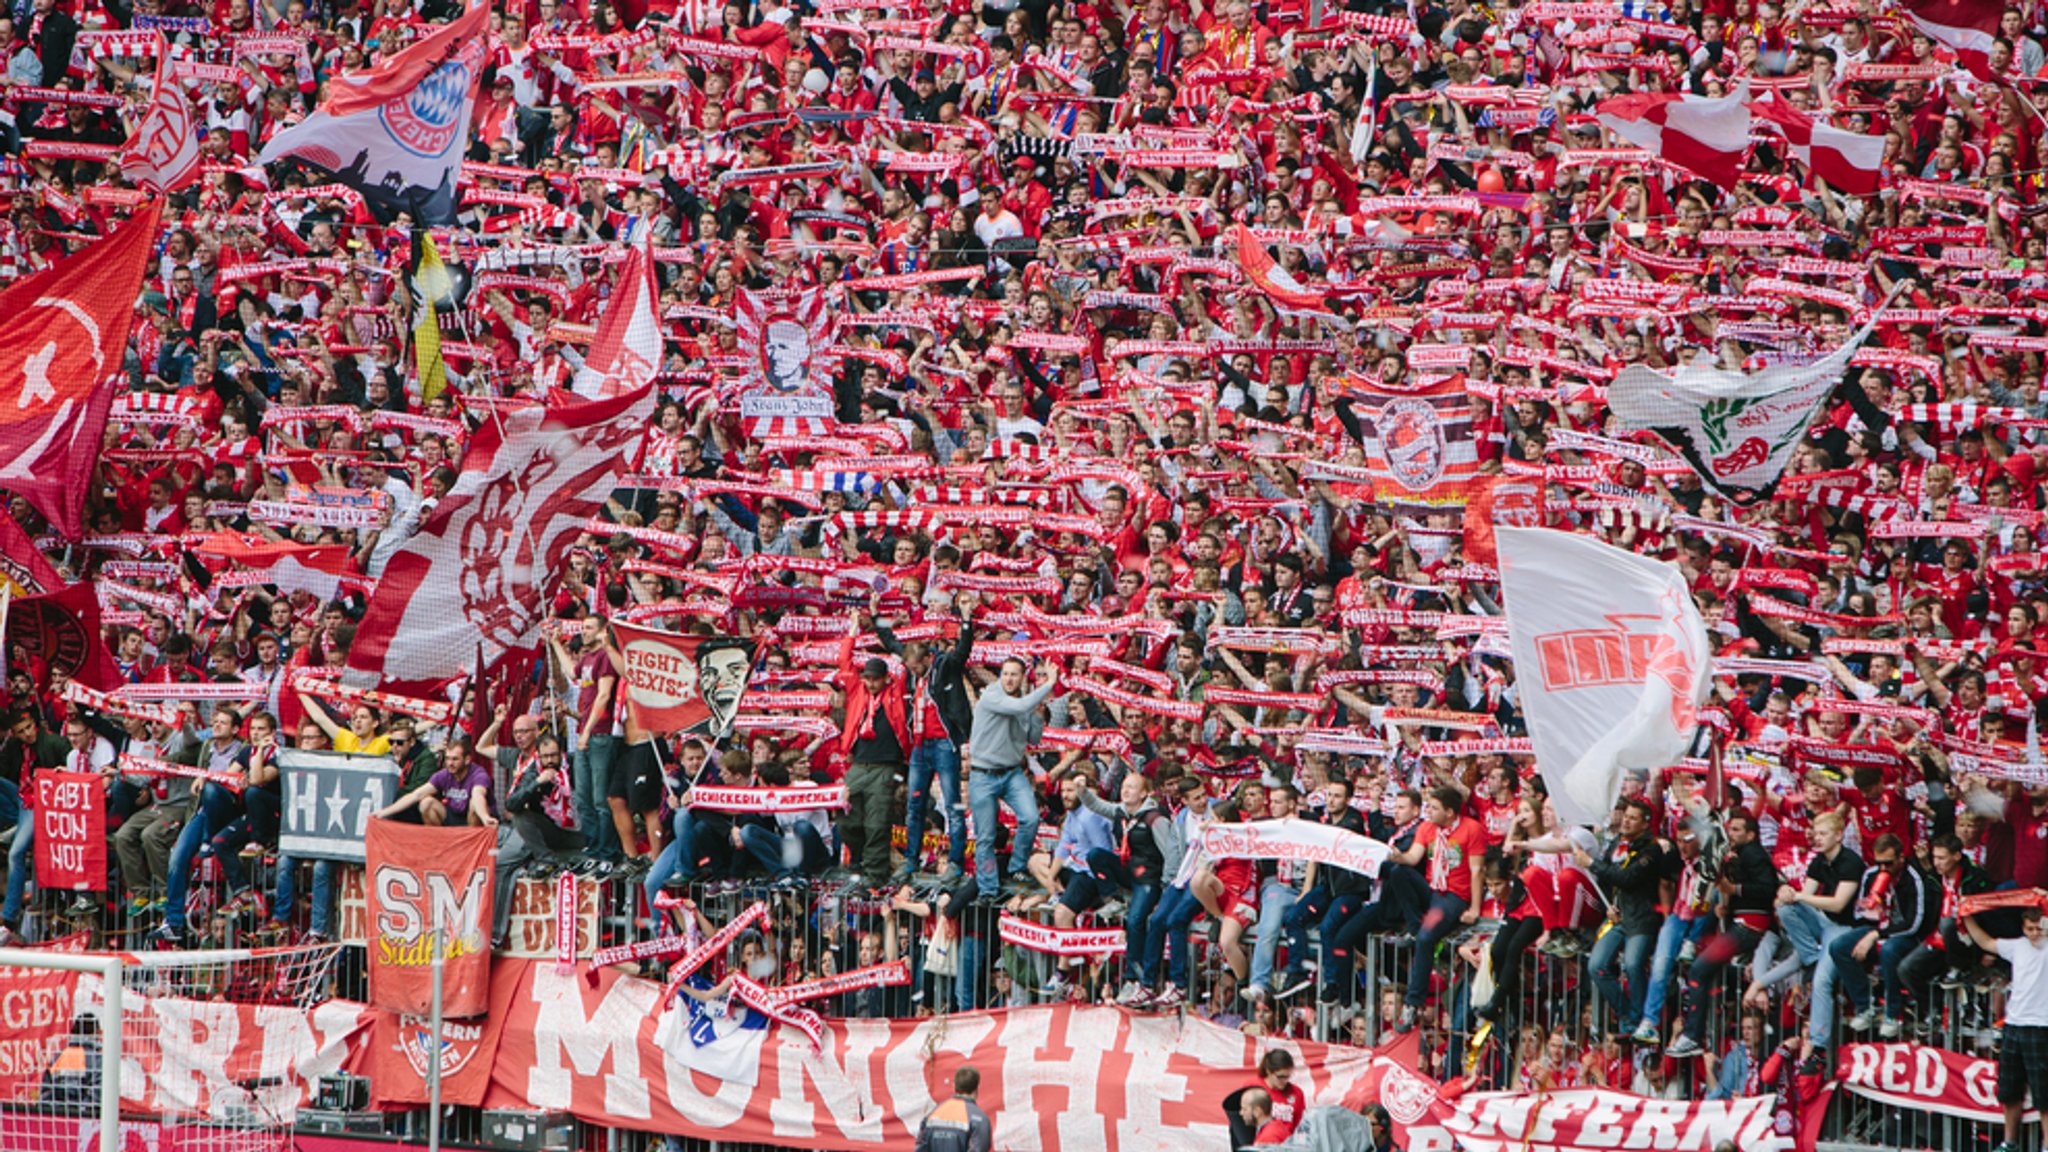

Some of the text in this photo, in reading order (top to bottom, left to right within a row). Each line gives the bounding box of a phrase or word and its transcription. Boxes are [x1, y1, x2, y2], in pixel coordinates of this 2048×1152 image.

[750, 397, 827, 416] Franz John
[1545, 464, 1603, 479] AYERN
[627, 649, 684, 674] FIGHT
[39, 780, 92, 811] FABI
[695, 790, 839, 807] SCHICKERIA MÜNCHEN
[45, 815, 87, 840] CON
[50, 848, 85, 873] NOI
[373, 863, 489, 946] SM
[1847, 1043, 1947, 1098] RED
